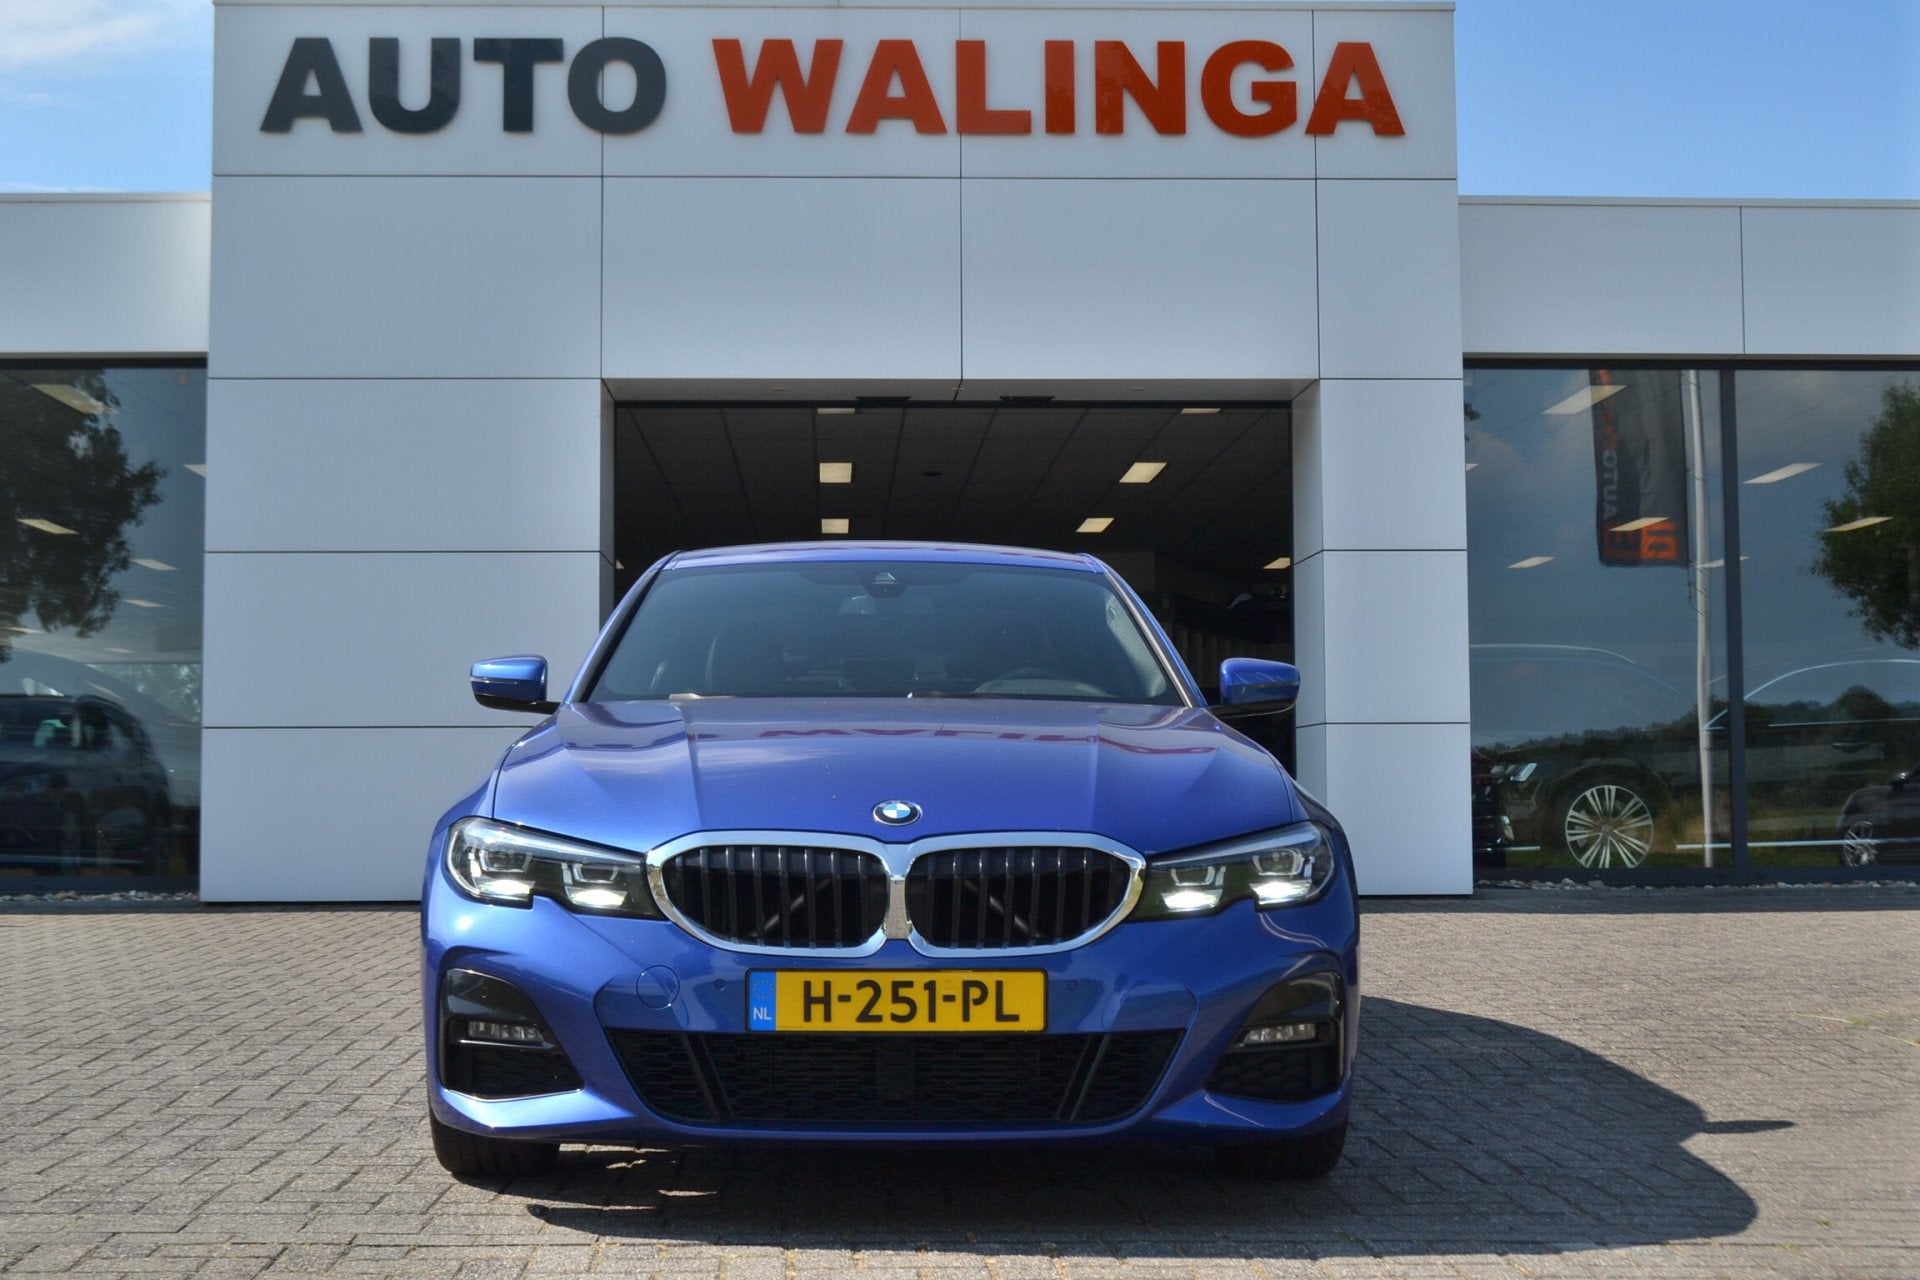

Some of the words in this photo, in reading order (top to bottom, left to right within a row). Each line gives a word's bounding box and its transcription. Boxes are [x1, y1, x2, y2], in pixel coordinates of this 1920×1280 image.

[260, 37, 666, 135] AUTO
[712, 39, 1405, 137] WALINGA
[753, 1007, 772, 1020] NL
[803, 980, 1020, 1023] H-251-PL
